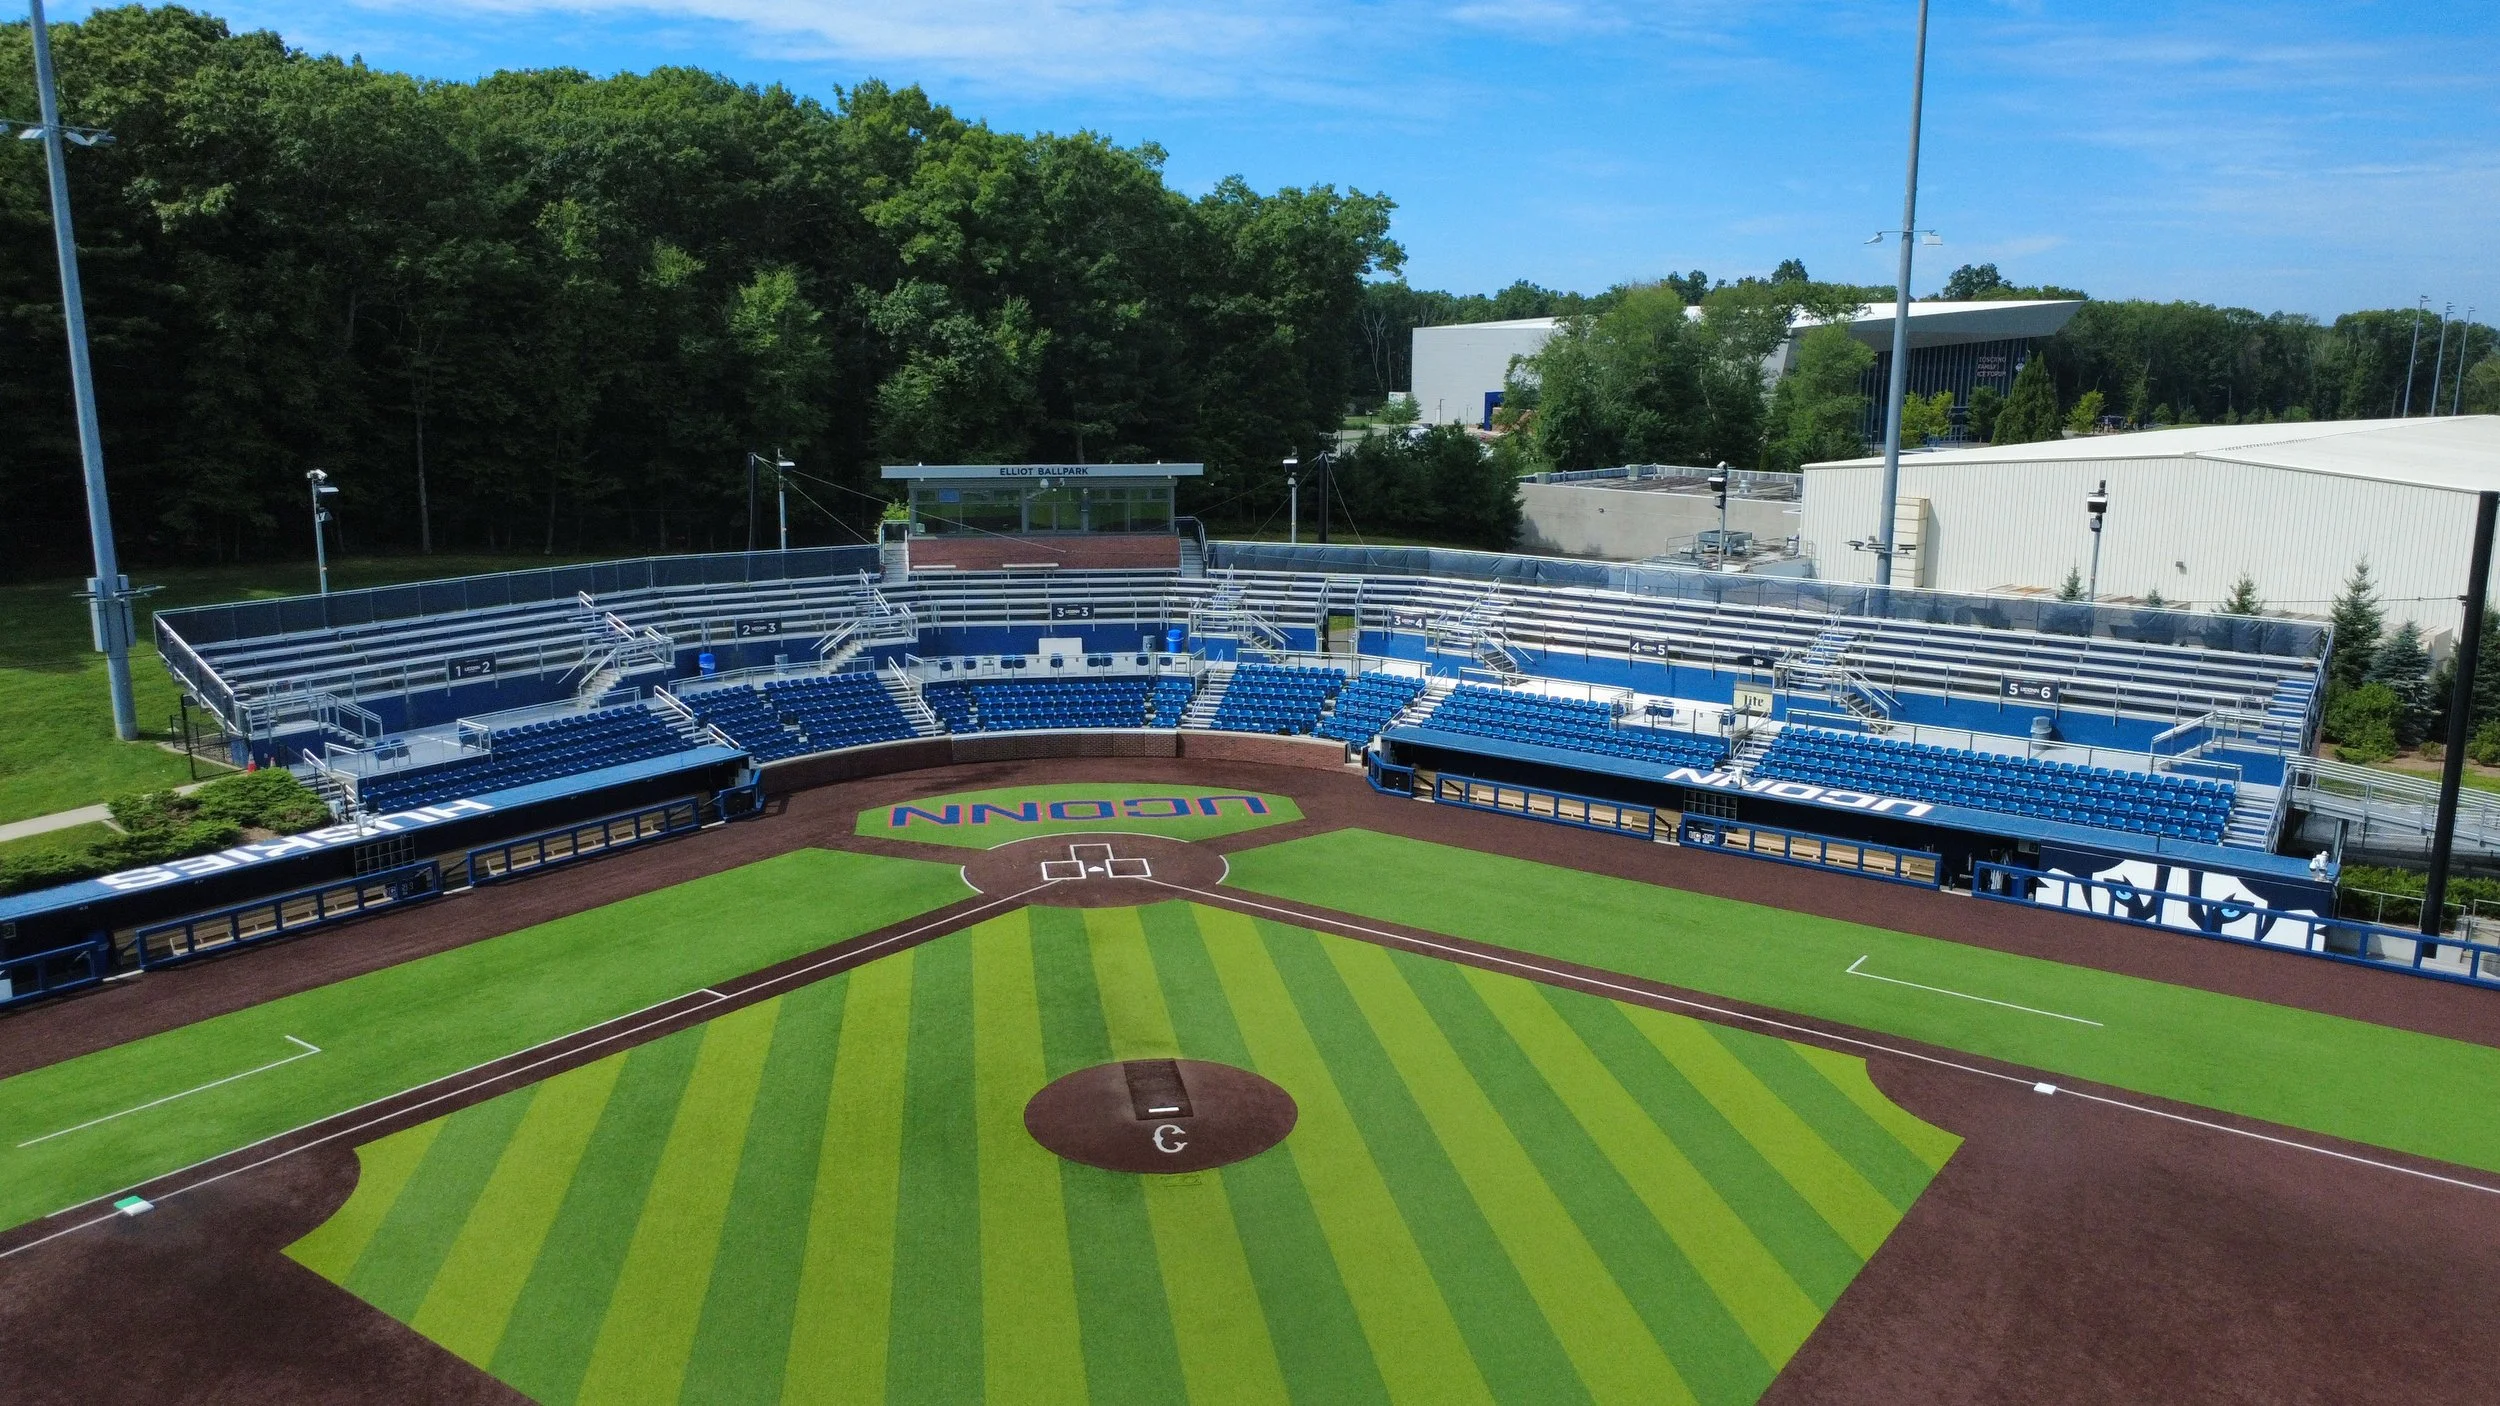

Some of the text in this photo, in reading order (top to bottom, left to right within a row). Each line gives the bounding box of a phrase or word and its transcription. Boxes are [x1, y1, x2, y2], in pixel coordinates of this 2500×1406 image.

[999, 467, 1089, 476] ELLIOT BALLPARK
[1056, 606, 1065, 618] 3
[1081, 606, 1089, 617] 3
[742, 624, 751, 636] 2
[768, 622, 777, 633] 3
[1393, 615, 1401, 626] 3
[1415, 618, 1423, 629] 4
[1631, 641, 1640, 653] 4
[1657, 644, 1666, 656] 5
[455, 665, 461, 677] 1
[482, 661, 491, 673] 2
[2008, 683, 2019, 696] 5
[2040, 686, 2051, 699] 6
[1663, 767, 1934, 817] UCONN
[888, 795, 1271, 829] UCONN
[97, 798, 495, 891] HUSKIES
